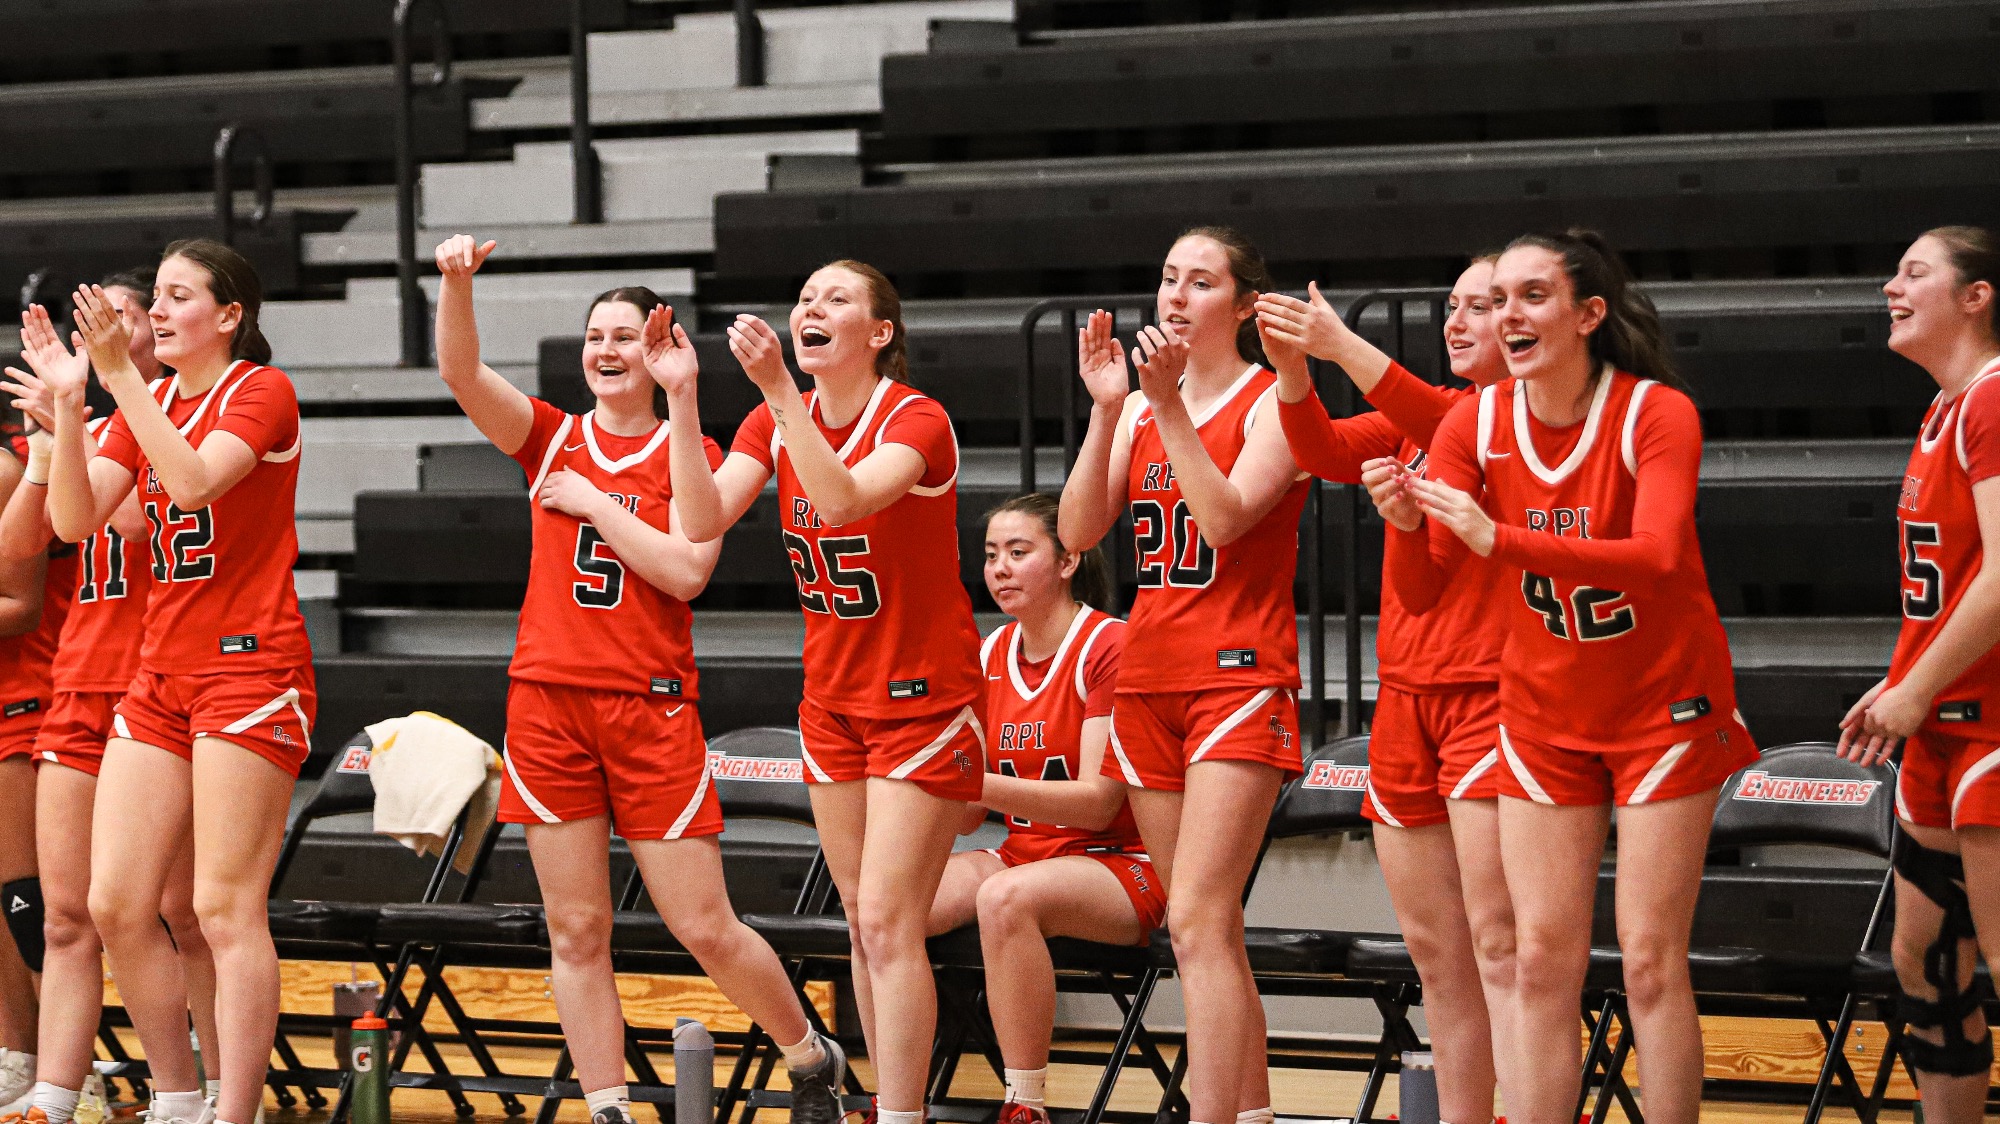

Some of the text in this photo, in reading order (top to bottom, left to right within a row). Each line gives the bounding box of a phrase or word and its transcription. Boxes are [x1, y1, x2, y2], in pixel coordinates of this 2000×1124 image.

[145, 500, 215, 583] 12
[1131, 498, 1217, 589] 20
[78, 521, 127, 604] 11
[573, 522, 625, 610] 5
[782, 528, 881, 620] 25
[1897, 519, 1943, 621] 5
[246, 639, 252, 647] S
[1244, 654, 1251, 662] M
[672, 683, 678, 692] S
[915, 684, 923, 692] M
[998, 721, 1046, 751] RPI
[1735, 771, 1878, 804] ENGINEERS
[352, 1046, 372, 1072] G
